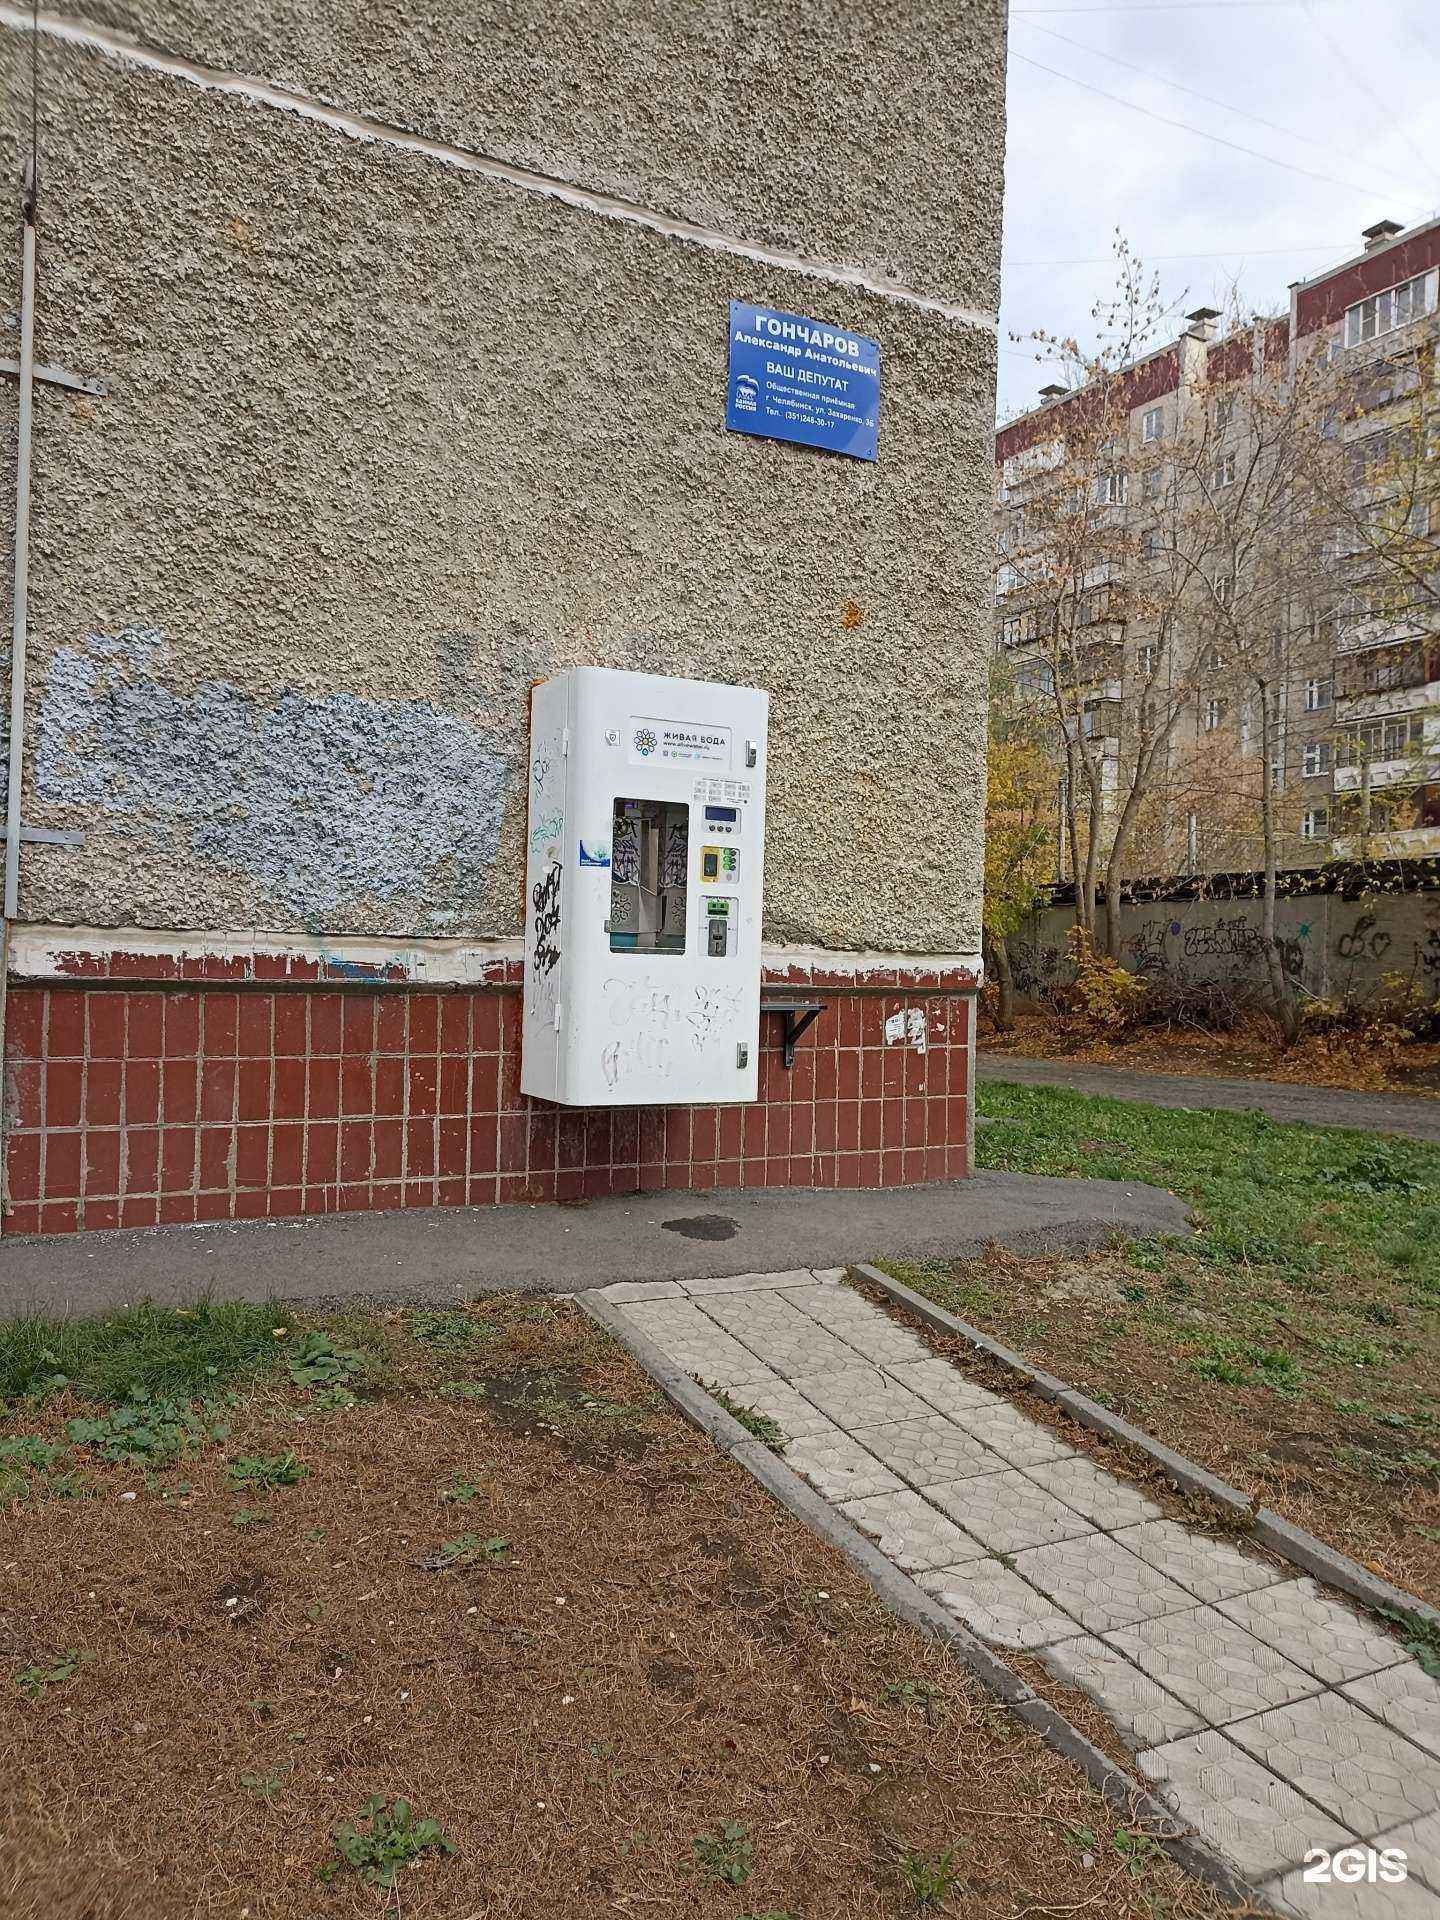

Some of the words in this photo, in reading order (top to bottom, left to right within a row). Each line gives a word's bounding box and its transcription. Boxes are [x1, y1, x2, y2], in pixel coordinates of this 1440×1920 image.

[754, 315, 860, 357] ГОНЧАРОВ
[734, 331, 801, 358] Александр
[804, 348, 877, 376] Анатольевич
[766, 362, 794, 379] ВАШ
[797, 368, 849, 392] ДЕПУТАТ
[766, 381, 820, 400] Общественная
[663, 731, 697, 742] ЖИВАЯ
